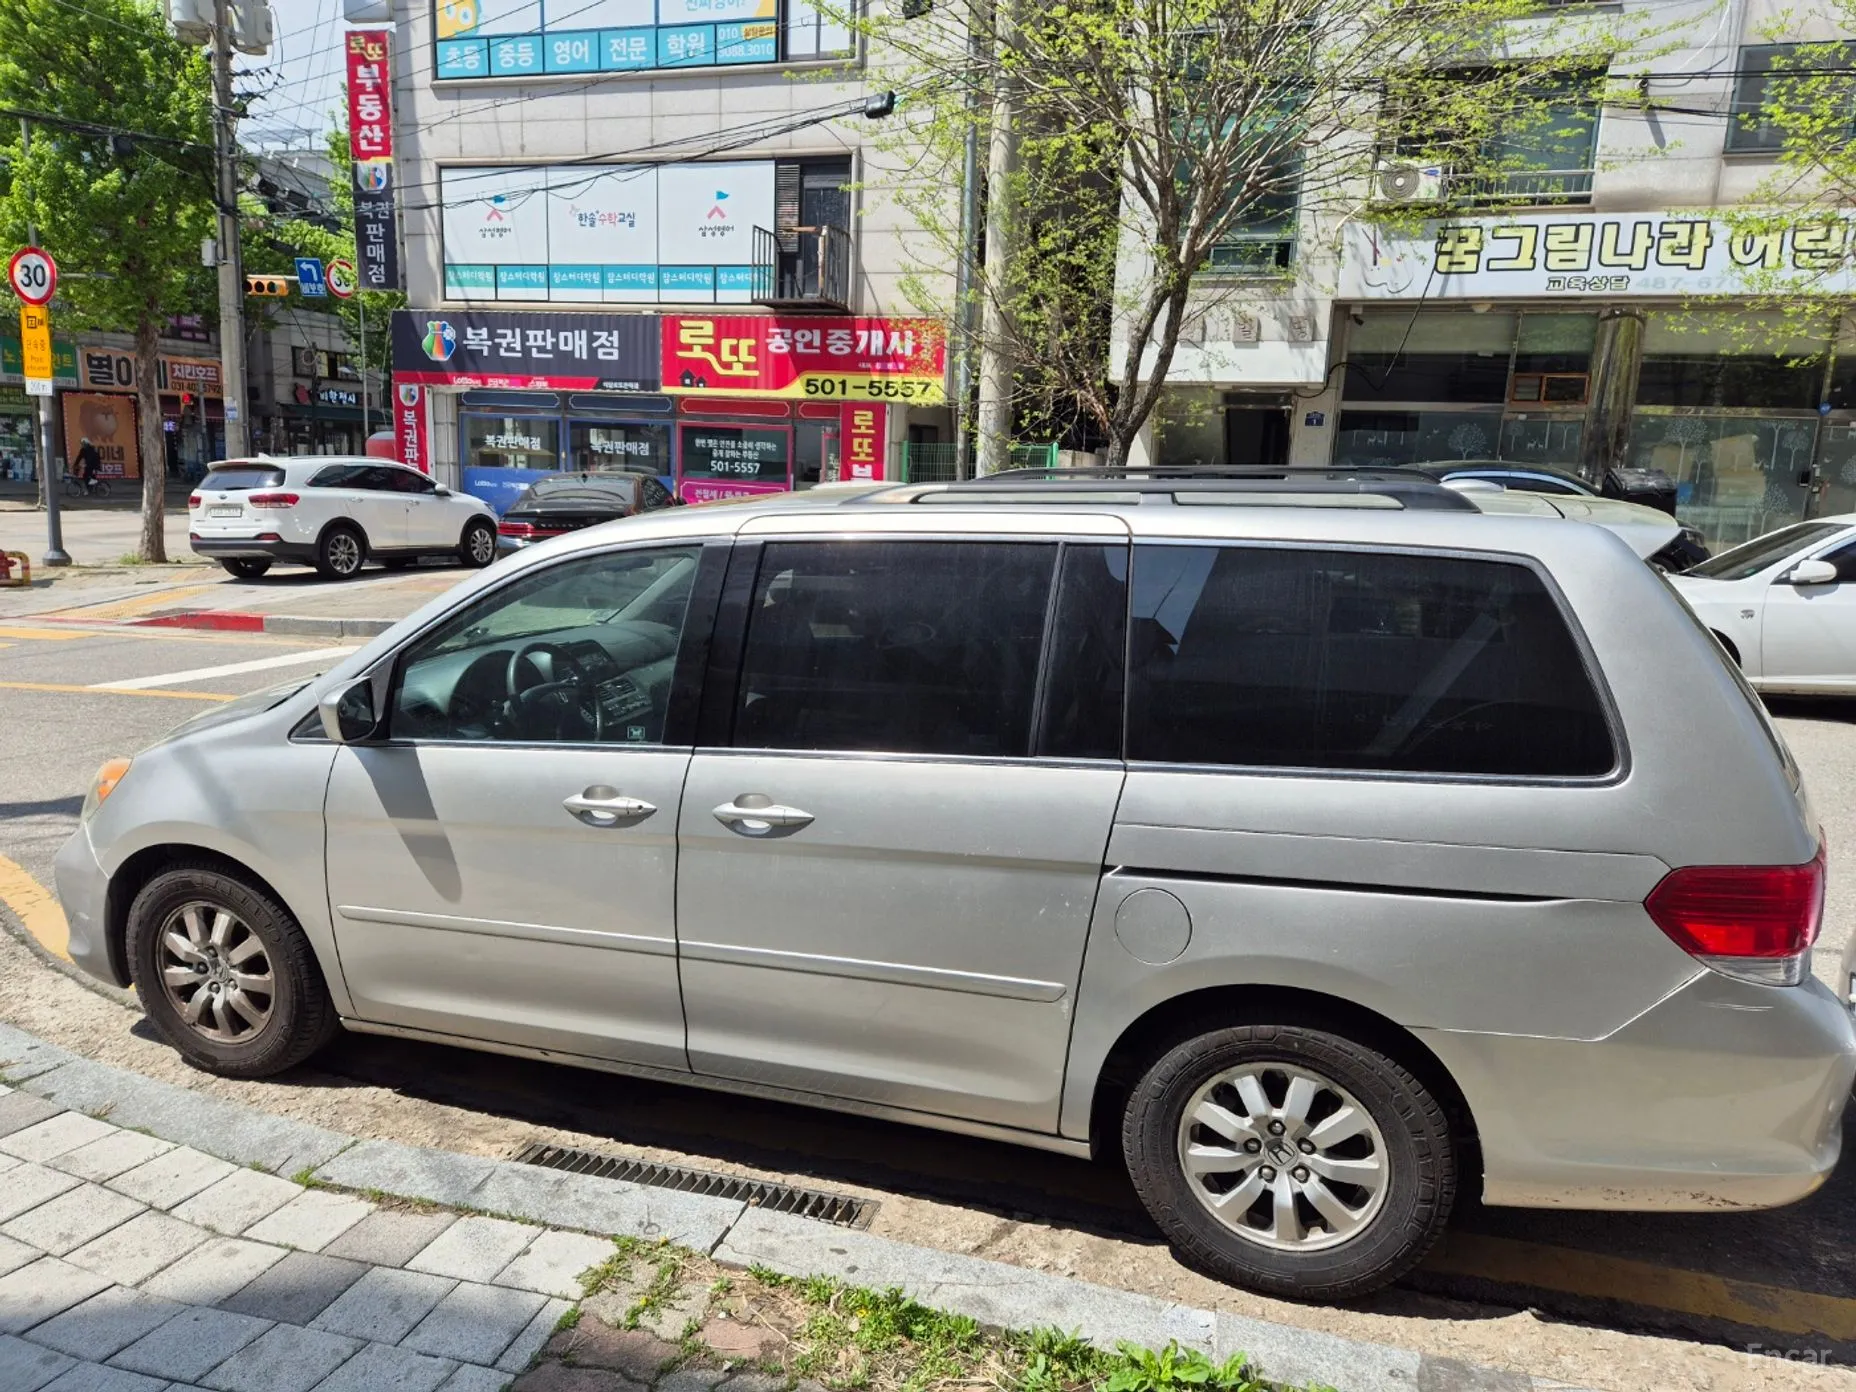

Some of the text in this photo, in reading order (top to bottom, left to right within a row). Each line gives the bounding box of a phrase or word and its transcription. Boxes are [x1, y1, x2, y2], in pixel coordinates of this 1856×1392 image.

[718, 27, 738, 40] 010
[350, 36, 385, 60] 로또
[445, 32, 706, 69] 초등 중등 영어 전문 학원
[356, 63, 384, 152] 부동산
[578, 211, 636, 227] 한솔수학교실
[365, 222, 386, 284] 판매점
[1435, 218, 1856, 275] 꿈그림나라 어린
[20, 264, 46, 287] 30
[1546, 275, 1630, 292] 교육상담
[463, 327, 620, 361] 복권판매점
[676, 320, 760, 376] 로또
[765, 328, 917, 357] 공인중개사
[172, 363, 218, 381] 치킨호프
[804, 378, 931, 398] 501-5557
[486, 434, 541, 450] 복권판매점
[850, 409, 876, 461] 로또
[591, 440, 650, 456] 복권판매점
[710, 460, 761, 475] 501-5557
